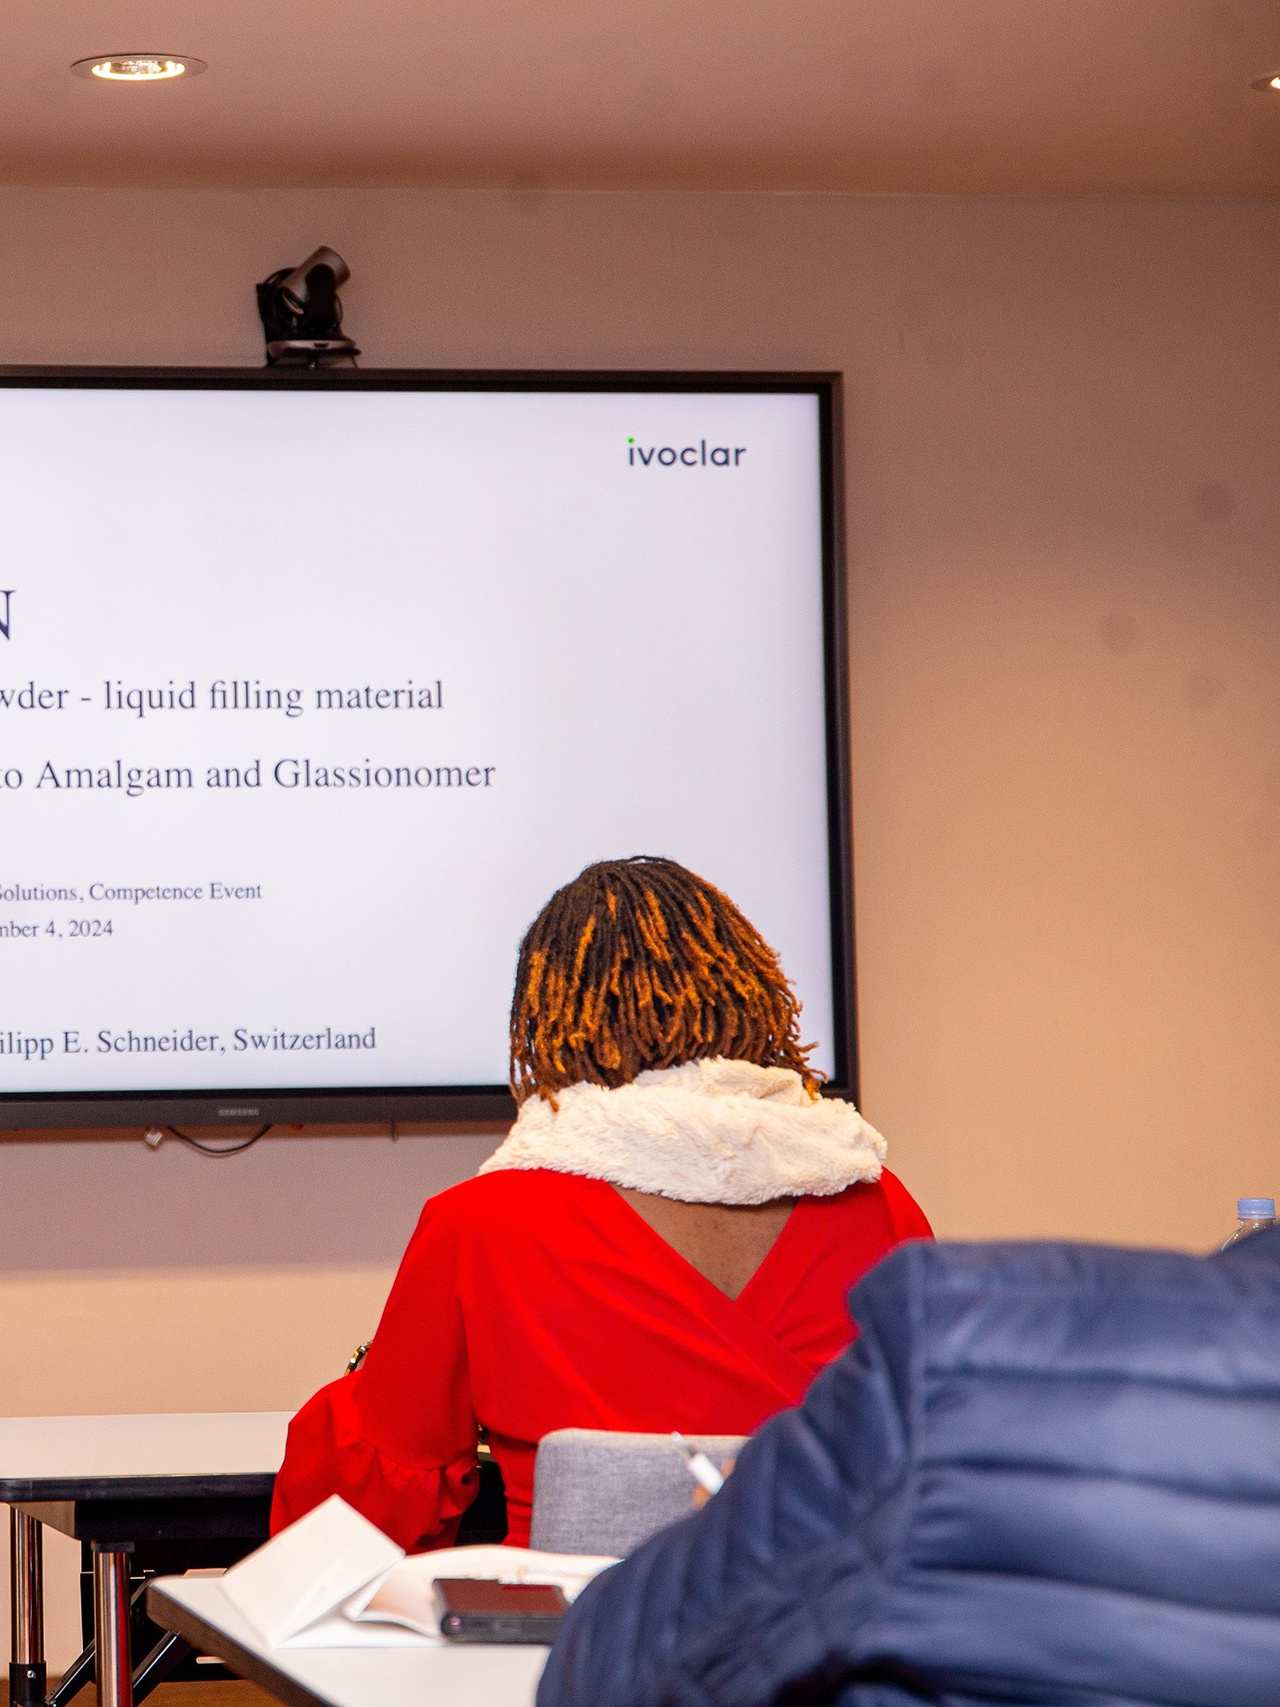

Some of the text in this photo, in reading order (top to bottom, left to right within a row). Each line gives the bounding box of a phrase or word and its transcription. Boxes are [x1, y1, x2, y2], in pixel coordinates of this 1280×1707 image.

[627, 437, 747, 468] ivoclar
[104, 680, 197, 719] liquid
[209, 680, 304, 719] filling
[315, 679, 443, 710] material
[35, 759, 193, 798] Amalgam
[206, 759, 262, 789] and
[273, 758, 497, 789] Glassionomer
[88, 883, 203, 905] Competence
[209, 882, 262, 900] Event
[45, 920, 63, 938] 4,
[69, 919, 114, 937] 2024
[62, 1030, 89, 1054] E.
[97, 1029, 226, 1055] Schneider,
[233, 1026, 376, 1052] Switzerland
